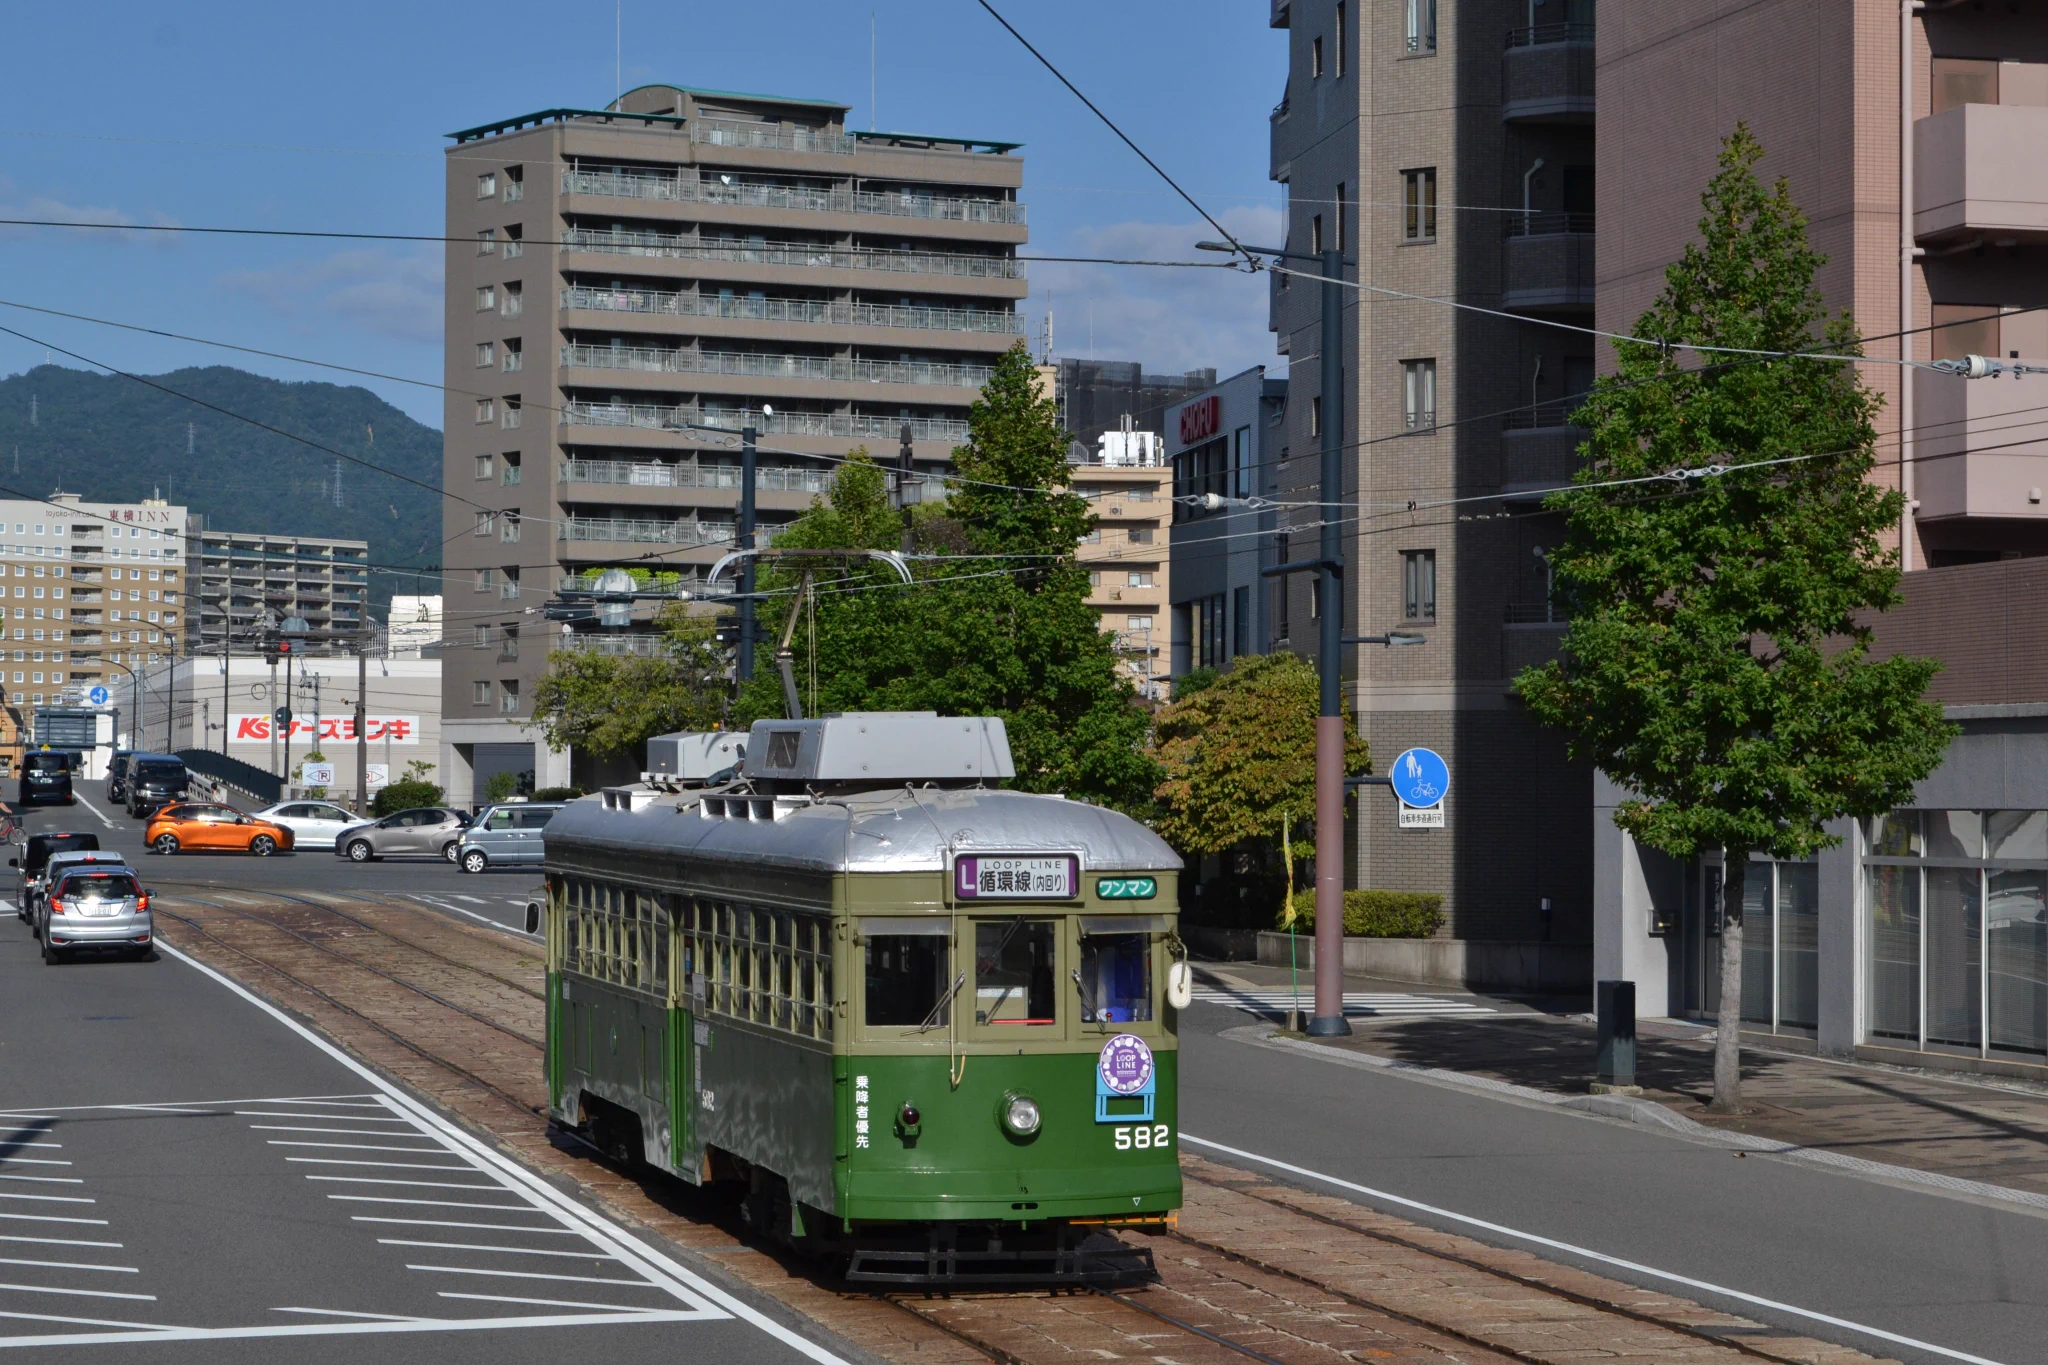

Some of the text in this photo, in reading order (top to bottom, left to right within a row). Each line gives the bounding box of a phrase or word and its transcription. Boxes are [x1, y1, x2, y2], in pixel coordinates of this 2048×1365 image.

[1180, 396, 1217, 443] CHOFU
[109, 509, 170, 522] 東横INN
[984, 860, 1062, 870] LOOP LINE
[961, 864, 976, 890] L
[1099, 879, 1154, 896] ワンマン
[1116, 1054, 1136, 1062] LOOP
[1116, 1061, 1136, 1069] LINE
[855, 1075, 869, 1149] 乗降者優先
[1114, 1124, 1169, 1150] 582
